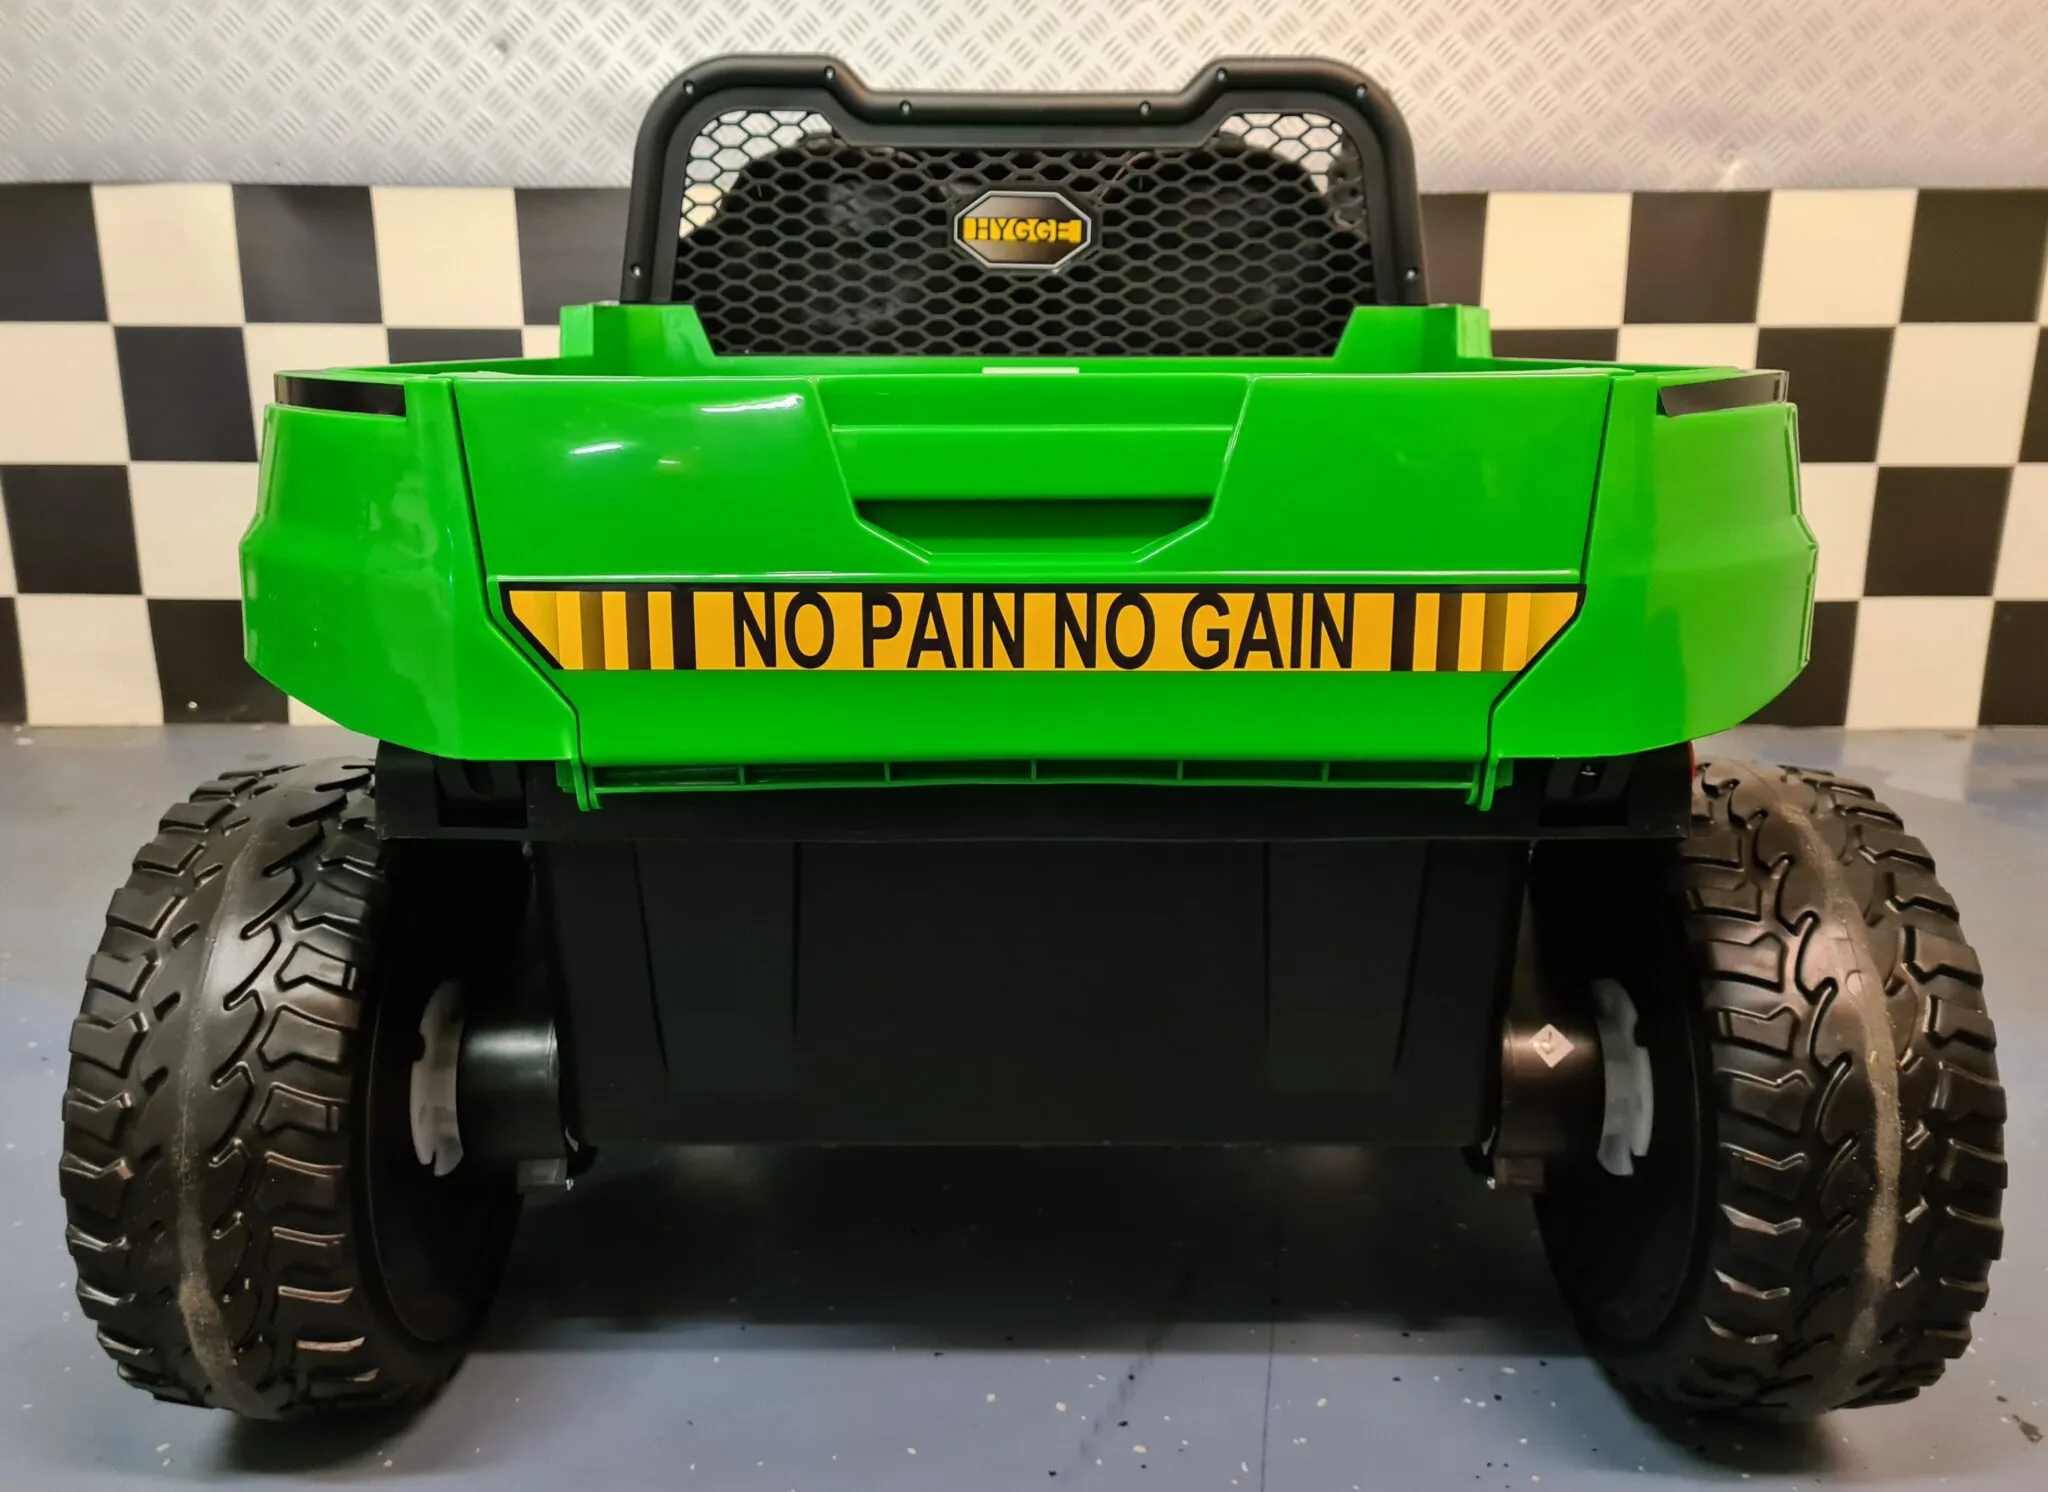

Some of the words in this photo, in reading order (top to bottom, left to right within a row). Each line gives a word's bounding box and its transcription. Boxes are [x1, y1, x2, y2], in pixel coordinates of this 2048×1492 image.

[973, 217, 1073, 242] HYGGE
[733, 592, 834, 668] NO
[862, 592, 1025, 668] PAIN
[1055, 592, 1155, 669] NO
[1181, 592, 1354, 669] GAIN
